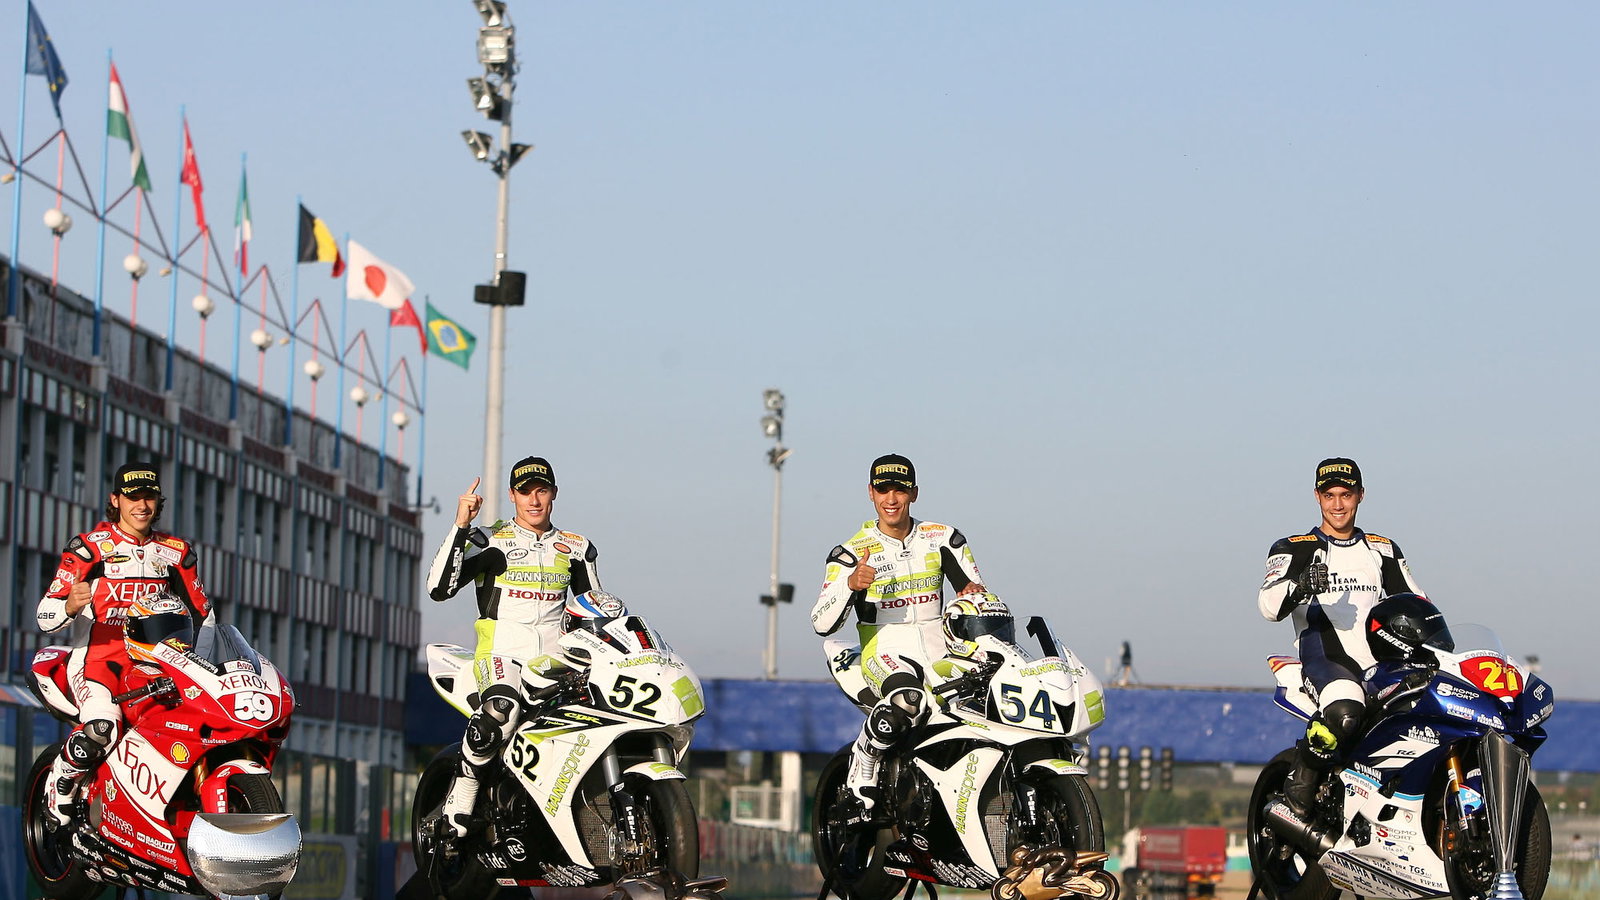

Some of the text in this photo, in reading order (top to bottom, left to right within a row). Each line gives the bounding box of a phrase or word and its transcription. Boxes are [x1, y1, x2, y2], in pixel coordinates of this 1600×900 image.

[514, 464, 547, 478] PIRELLI
[875, 464, 909, 475] PIRELLI
[1319, 464, 1352, 477] PIRELLI
[508, 589, 562, 601] HONDA
[881, 593, 939, 609] HONDA
[1025, 616, 1060, 658] 1
[218, 674, 273, 692] XEROX
[608, 674, 662, 718] 52
[233, 692, 275, 721] 59
[1000, 682, 1057, 730] 54
[511, 731, 540, 782] 52
[544, 732, 590, 818] HANNspree
[216, 788, 226, 813] PIRE
[955, 752, 979, 835] HANNspree
[507, 843, 525, 855] RES
[485, 852, 508, 869] ids
[1409, 864, 1425, 876] TGS
